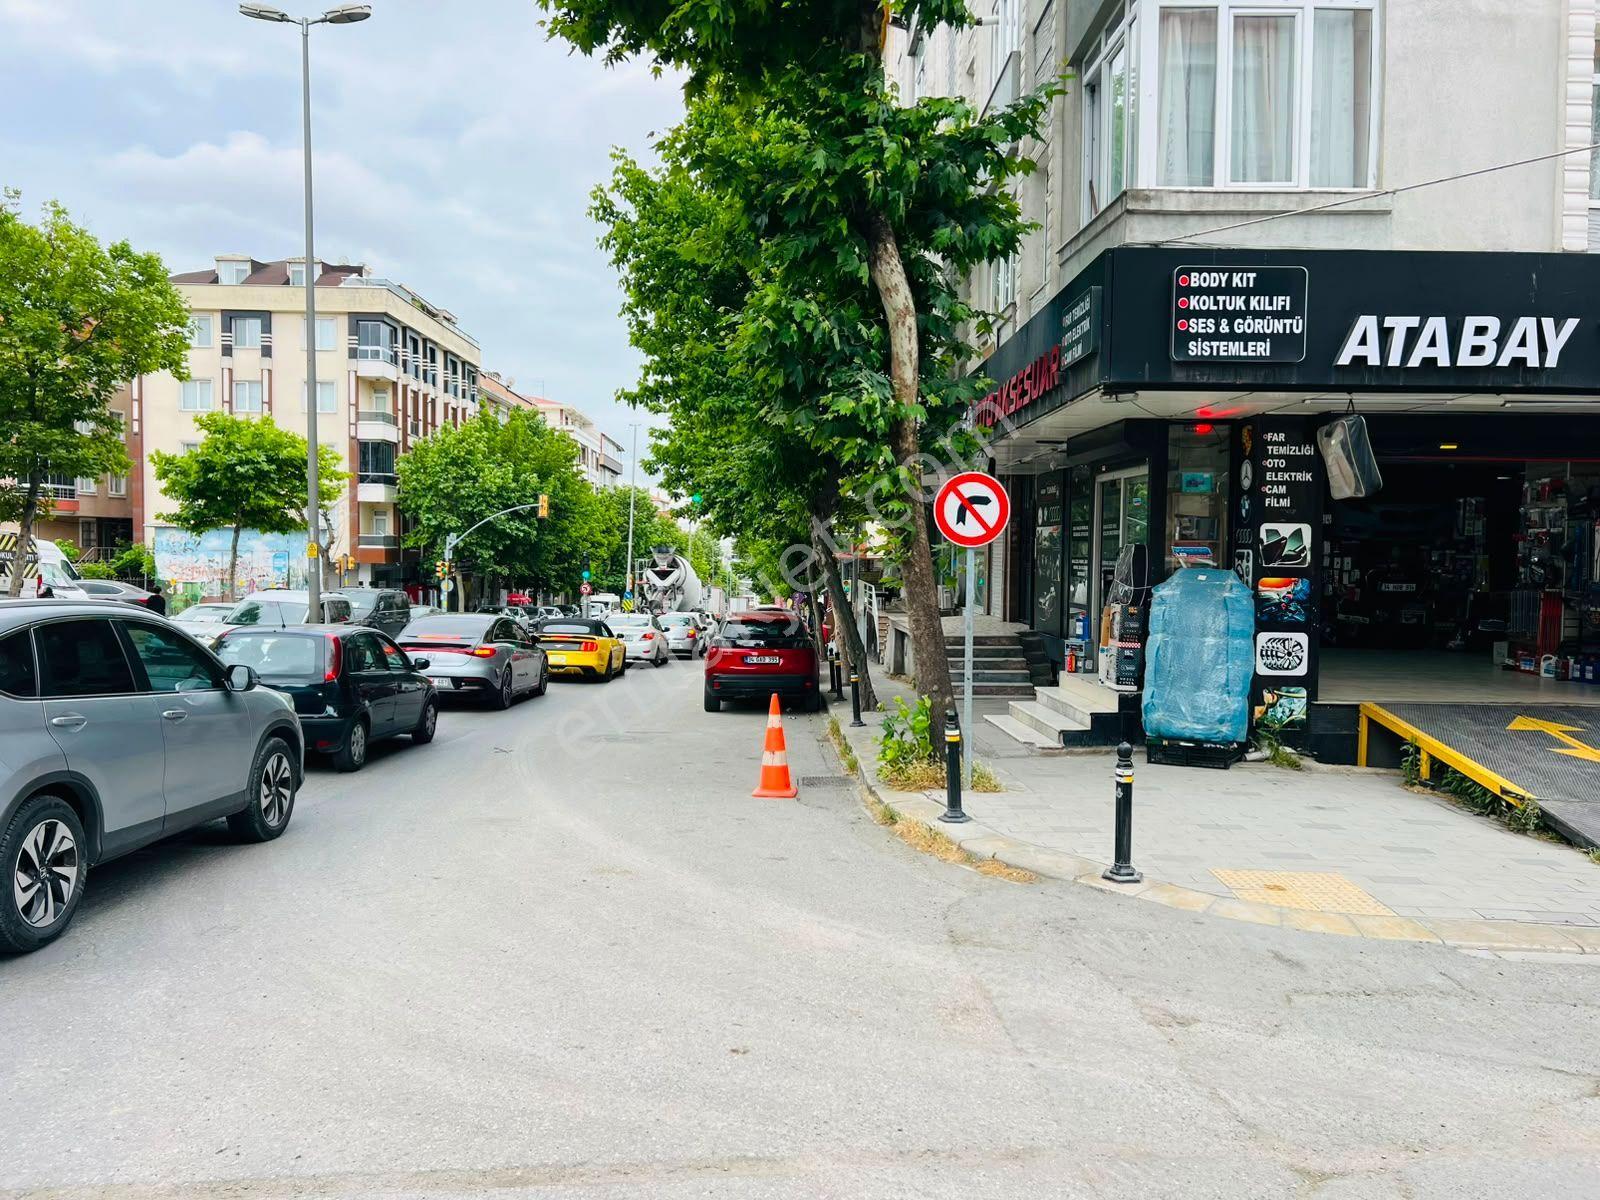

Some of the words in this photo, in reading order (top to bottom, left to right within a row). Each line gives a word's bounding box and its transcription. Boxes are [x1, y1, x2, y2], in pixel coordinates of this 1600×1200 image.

[1190, 272, 1229, 287] BODY
[1232, 272, 1257, 287] KIT
[1189, 295, 1246, 310] KOLTUK
[1249, 295, 1290, 311] KILIFI
[1188, 318, 1216, 333] SES
[1219, 318, 1230, 333] &
[1233, 315, 1303, 334] GÖRÜNTÜ
[1188, 338, 1270, 356] SİSTEMLERİ
[1336, 315, 1581, 368] ATABAY
[1267, 432, 1286, 442] FAR
[1267, 444, 1315, 456] TEMİZLİĞİ
[1266, 459, 1286, 468] OTO
[1266, 470, 1313, 482] ELEKTRİK
[1265, 485, 1287, 494] CAM
[1265, 496, 1291, 507] FİLMİ
